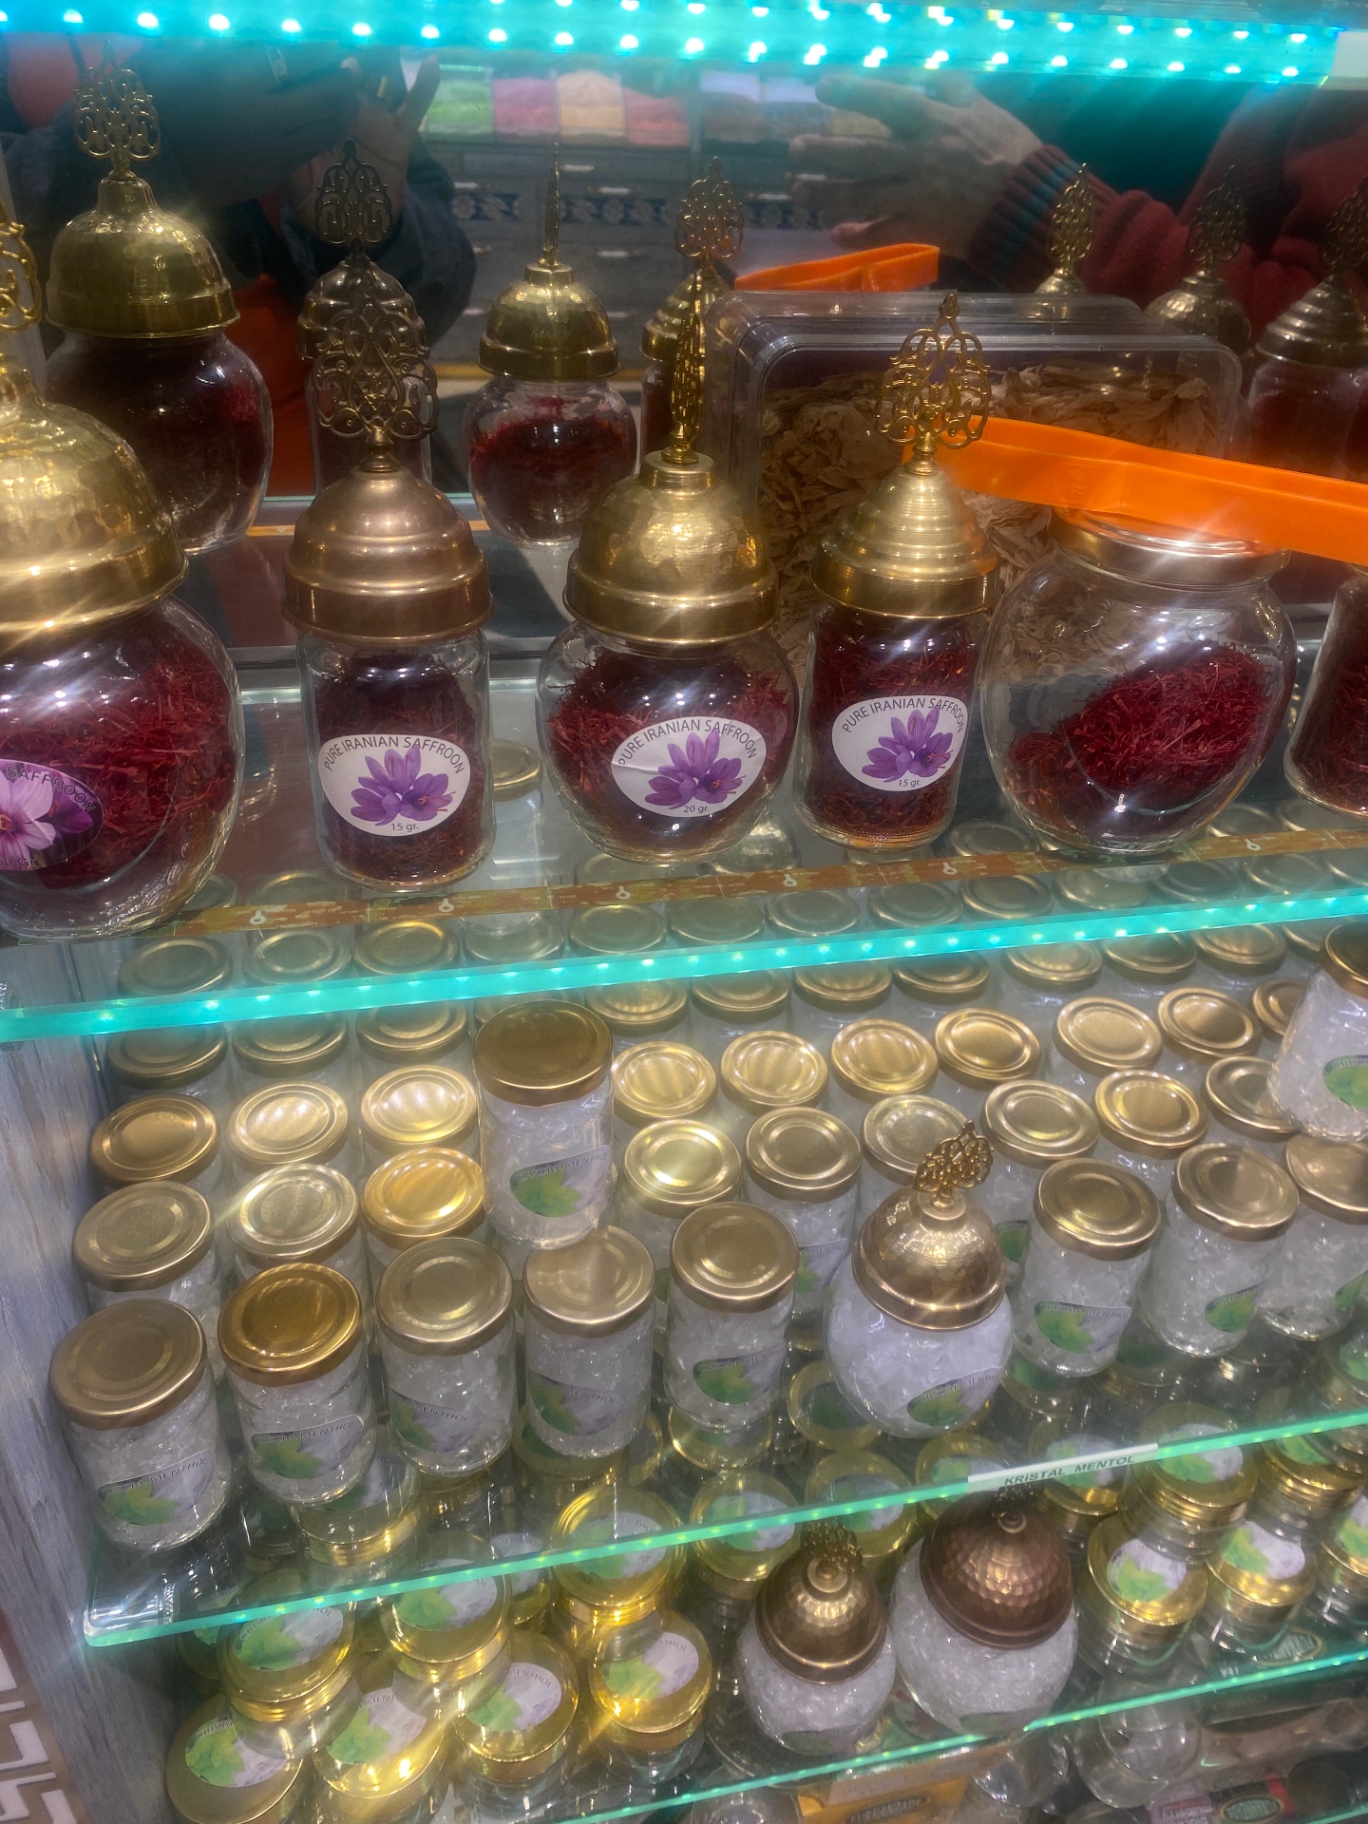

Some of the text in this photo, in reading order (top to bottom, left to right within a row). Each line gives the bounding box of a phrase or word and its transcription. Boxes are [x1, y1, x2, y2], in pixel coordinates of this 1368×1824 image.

[842, 698, 964, 733] PURE IRANIAN SAFFROON
[324, 736, 465, 774] PURE IRANIAN SAFFROON
[618, 719, 758, 766] PURE IRANIAN SAFFROON
[6, 766, 96, 812] SAFFROON
[898, 779, 908, 787] 15
[683, 805, 696, 813] 20
[391, 822, 403, 831] 15
[1004, 1456, 1136, 1485] KRISTAL MENTOL
